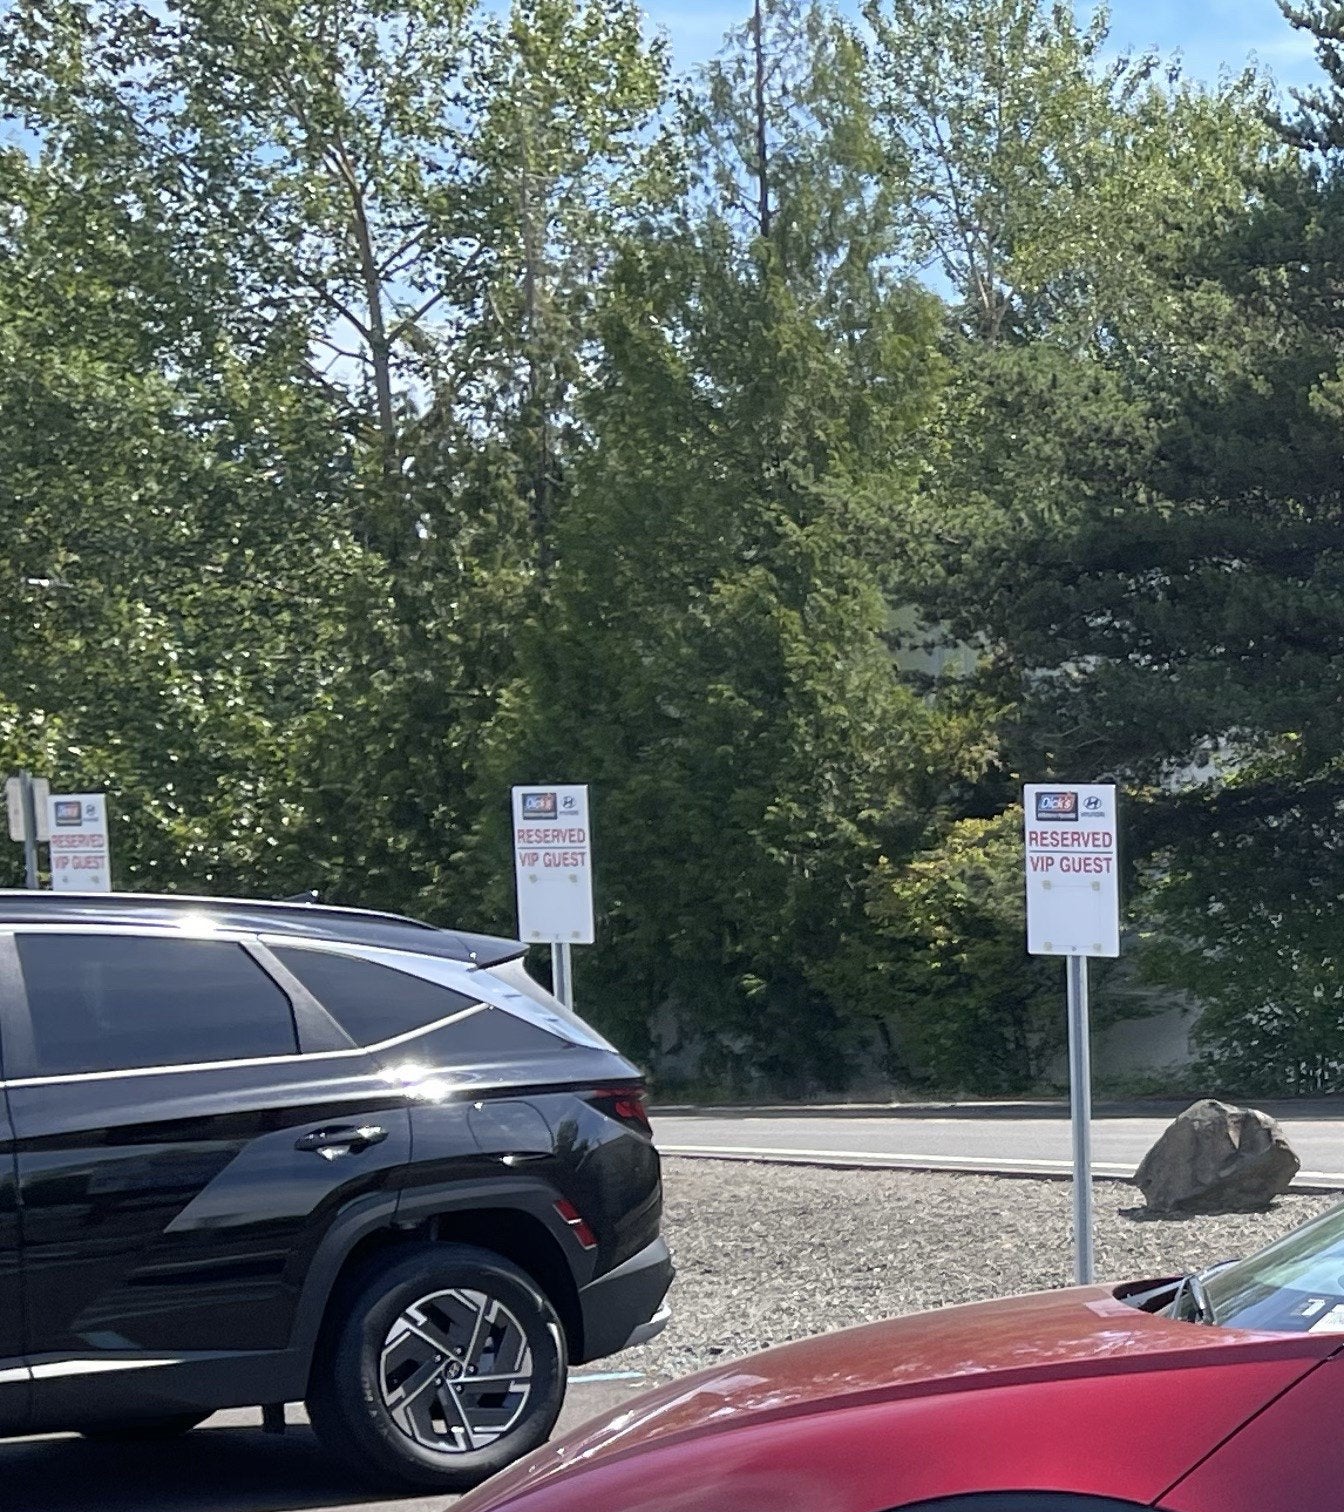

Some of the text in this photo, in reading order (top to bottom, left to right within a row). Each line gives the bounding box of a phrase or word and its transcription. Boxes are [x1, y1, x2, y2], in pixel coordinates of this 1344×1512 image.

[516, 828, 586, 844] RESERVED
[1028, 831, 1113, 848] RESERVED
[1030, 856, 1113, 874] VIP GUEST
